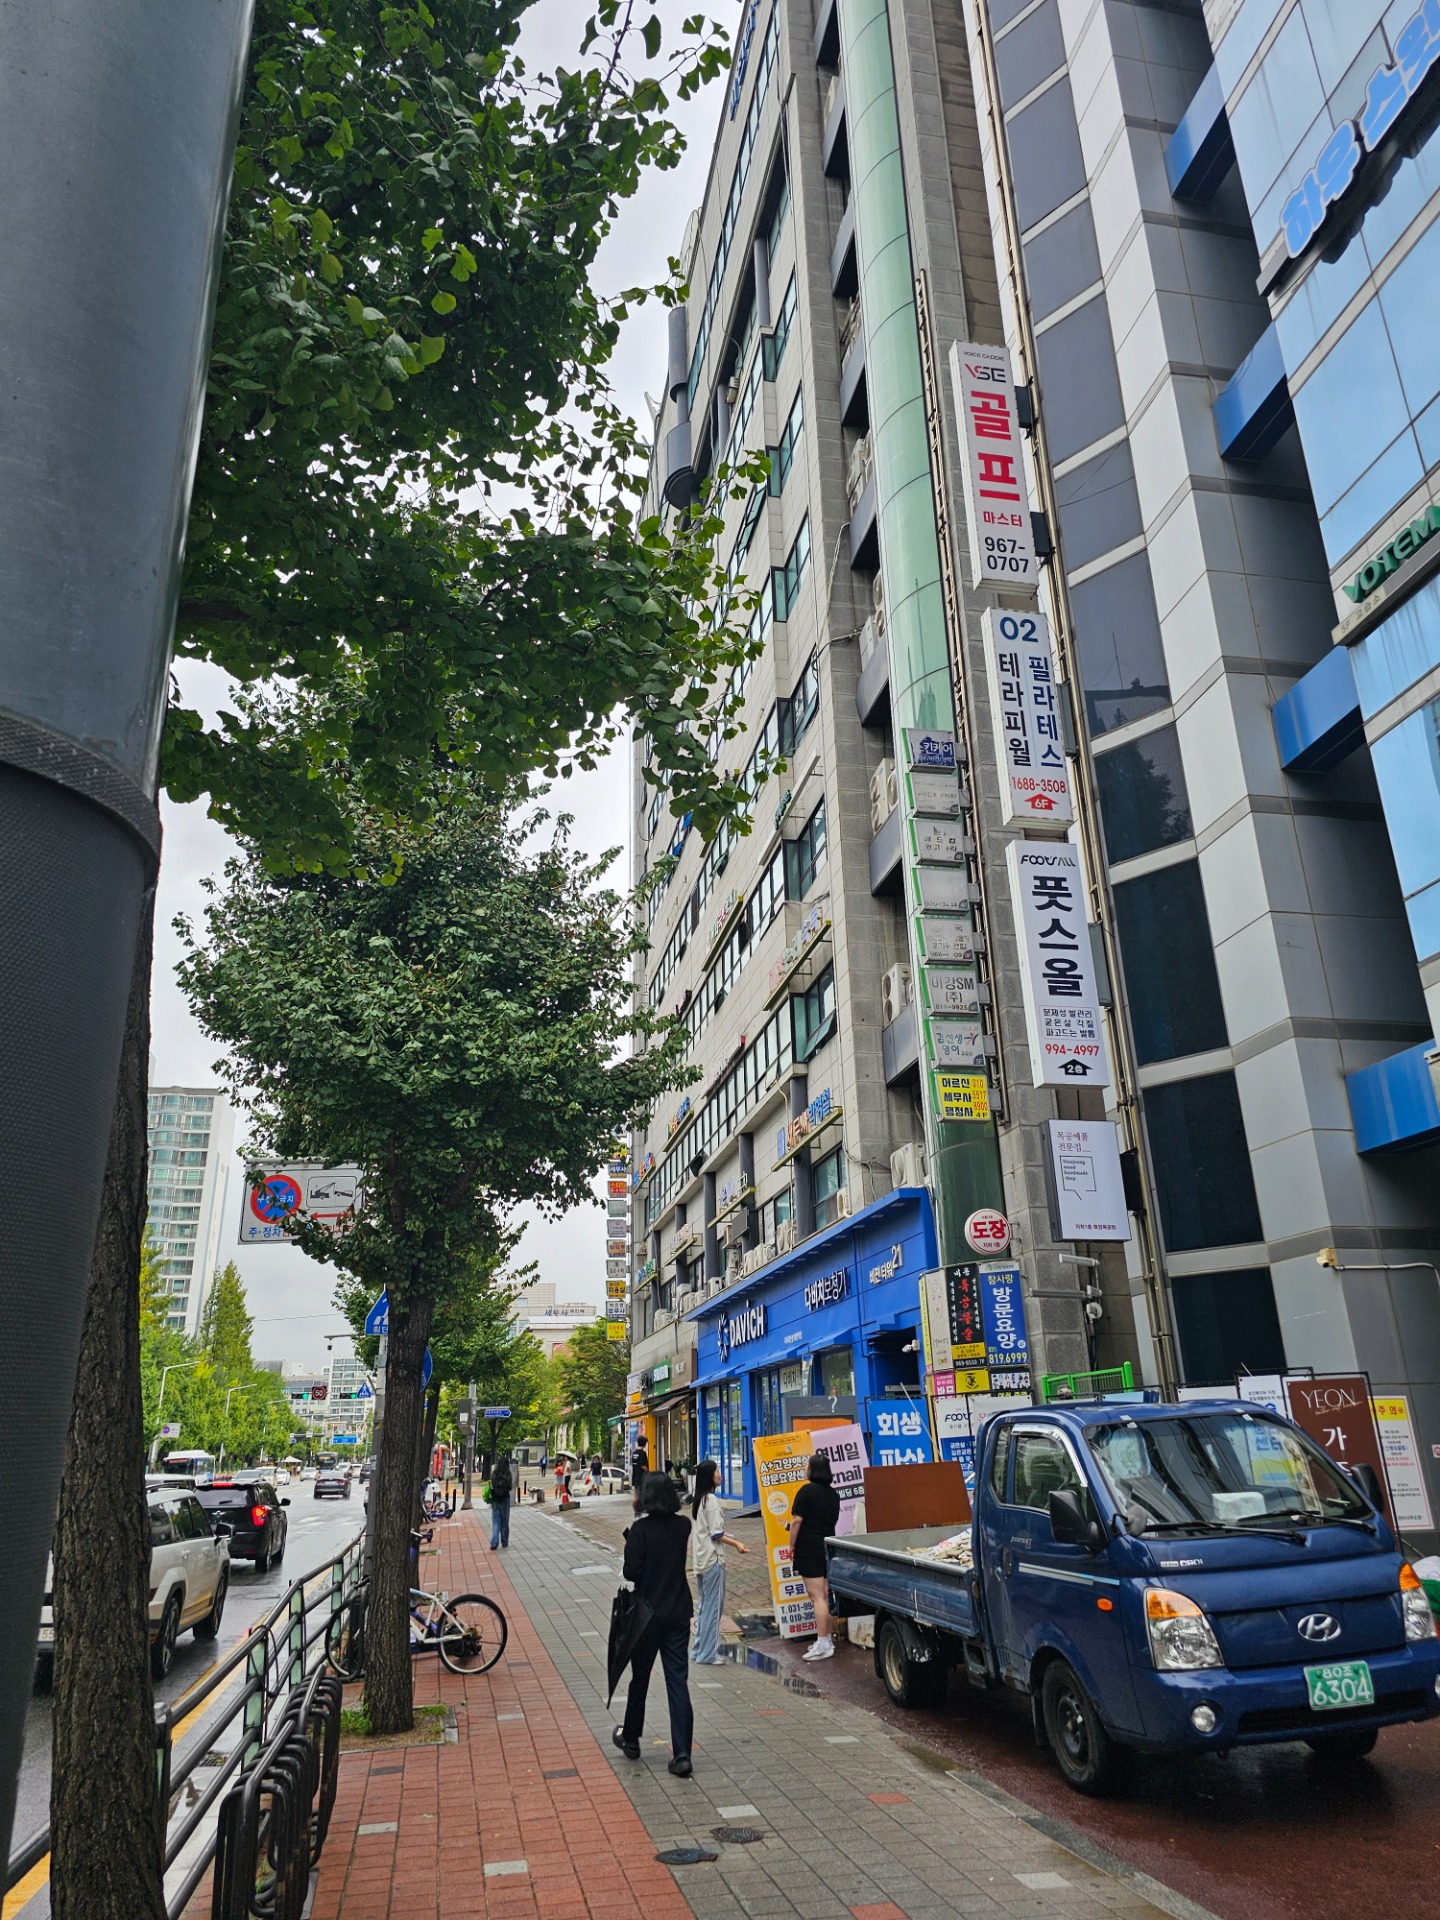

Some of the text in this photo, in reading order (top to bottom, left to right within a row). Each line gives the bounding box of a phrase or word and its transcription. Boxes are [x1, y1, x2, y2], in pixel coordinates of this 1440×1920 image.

[981, 353, 1005, 361] CADDIE
[970, 390, 1021, 502] 골프
[983, 511, 1022, 527] 마스터
[984, 537, 1026, 554] 967-
[987, 555, 1029, 573] 0707
[998, 652, 1032, 767] 테라피월
[1028, 656, 1064, 768] 필라테스
[1011, 776, 1067, 794] 1688-3508
[1034, 798, 1049, 809] 6F
[1031, 874, 1084, 997] 풋스올
[931, 975, 974, 990] 미강SM
[945, 991, 963, 1003] (주)
[1043, 1008, 1093, 1018] 문제성 발관리
[1077, 1019, 1094, 1028] 각질
[935, 1032, 963, 1044] 김선생
[1046, 1028, 1078, 1038] 파고드는
[941, 1045, 960, 1056] 영어
[1045, 1043, 1100, 1056] 994-4997
[941, 1077, 970, 1088] 어르신
[944, 1091, 972, 1103] 세무사
[945, 1106, 974, 1117] 행정사
[972, 1219, 1006, 1240] 도장
[891, 1243, 904, 1269] 21
[987, 1274, 1014, 1285] 참사랑
[804, 1267, 848, 1311] 다비치보청기
[992, 1287, 1017, 1349] 방문요양
[988, 1352, 1028, 1364] 819.6999
[1300, 1388, 1356, 1409] YEON
[876, 1411, 922, 1436] 회생
[760, 1467, 812, 1487] 방문요양센
[837, 1485, 865, 1499] 빌딩 6층
[1322, 1665, 1353, 1678] 80조
[1313, 1670, 1371, 1705] 6304
